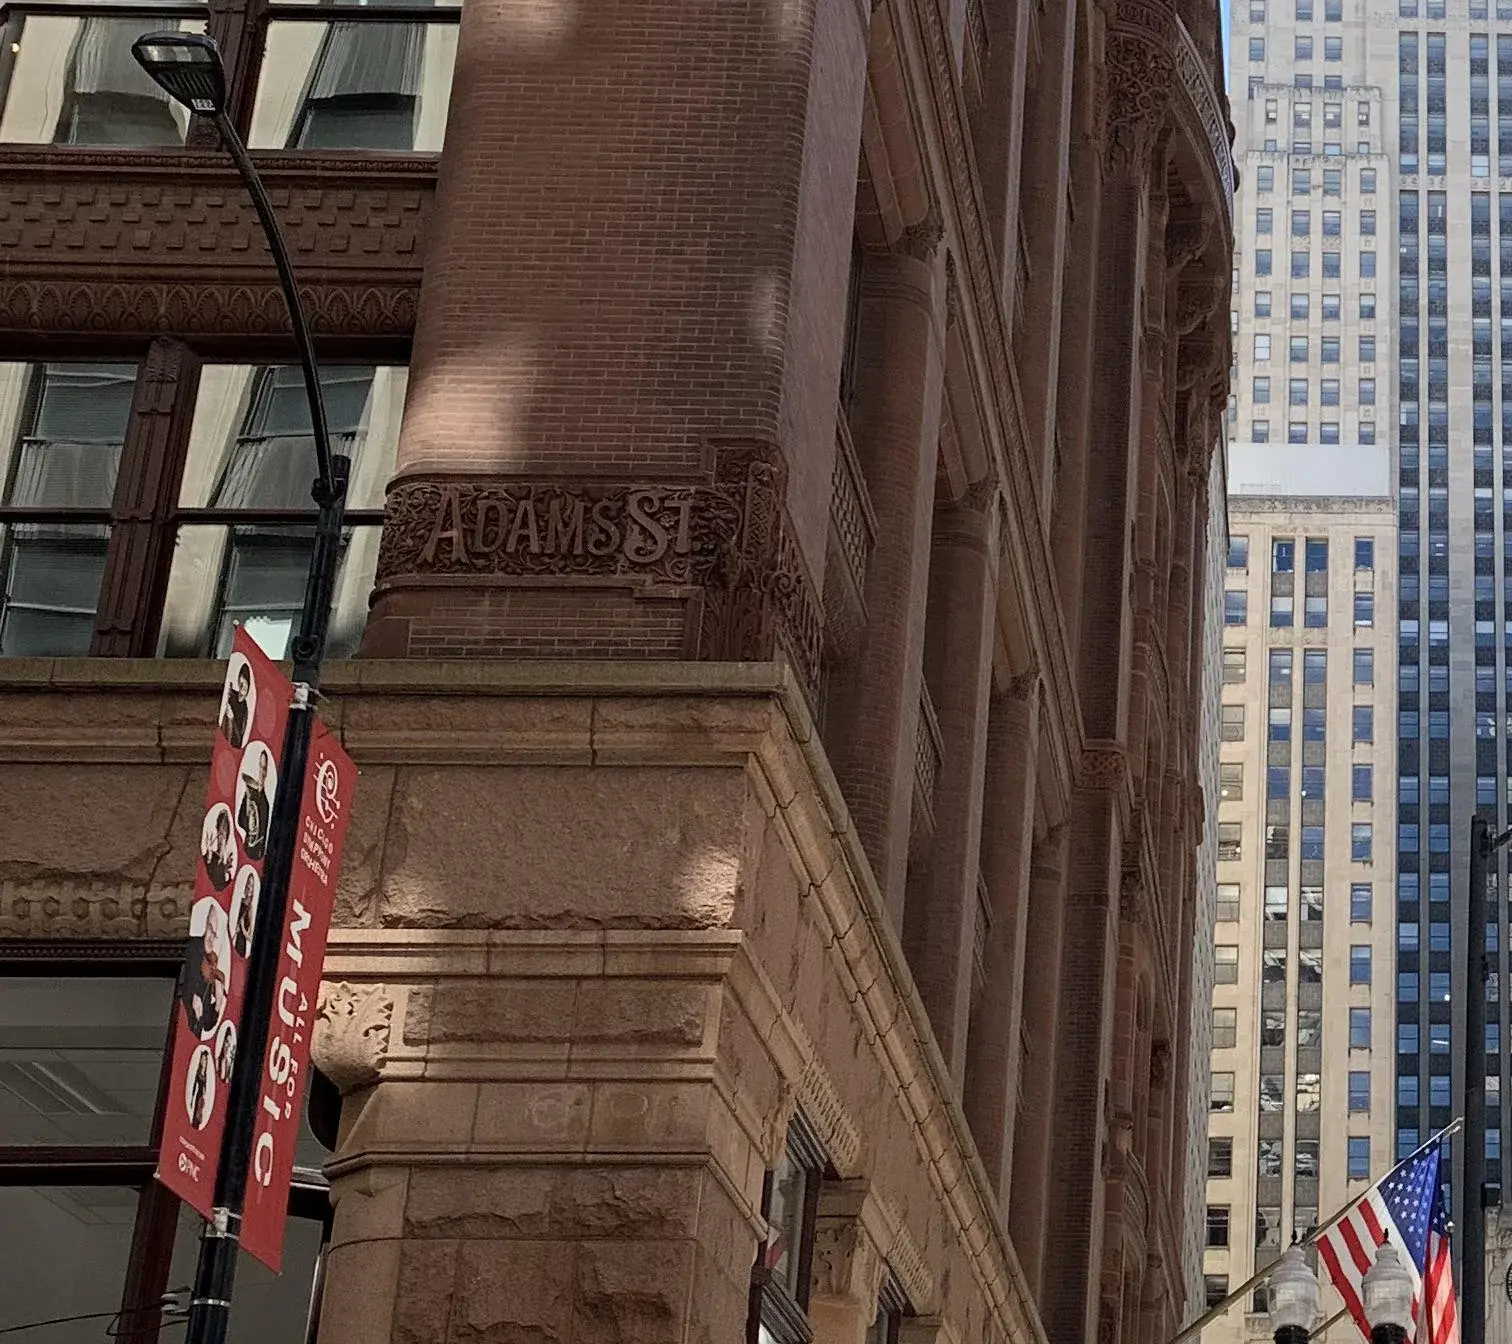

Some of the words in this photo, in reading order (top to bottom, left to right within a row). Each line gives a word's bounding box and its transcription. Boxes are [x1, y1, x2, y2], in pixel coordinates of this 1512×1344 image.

[416, 485, 621, 563] ADAMS
[253, 898, 312, 1188] MUSIC
[292, 990, 309, 1044] ALL
[284, 1058, 299, 1120] FOR
